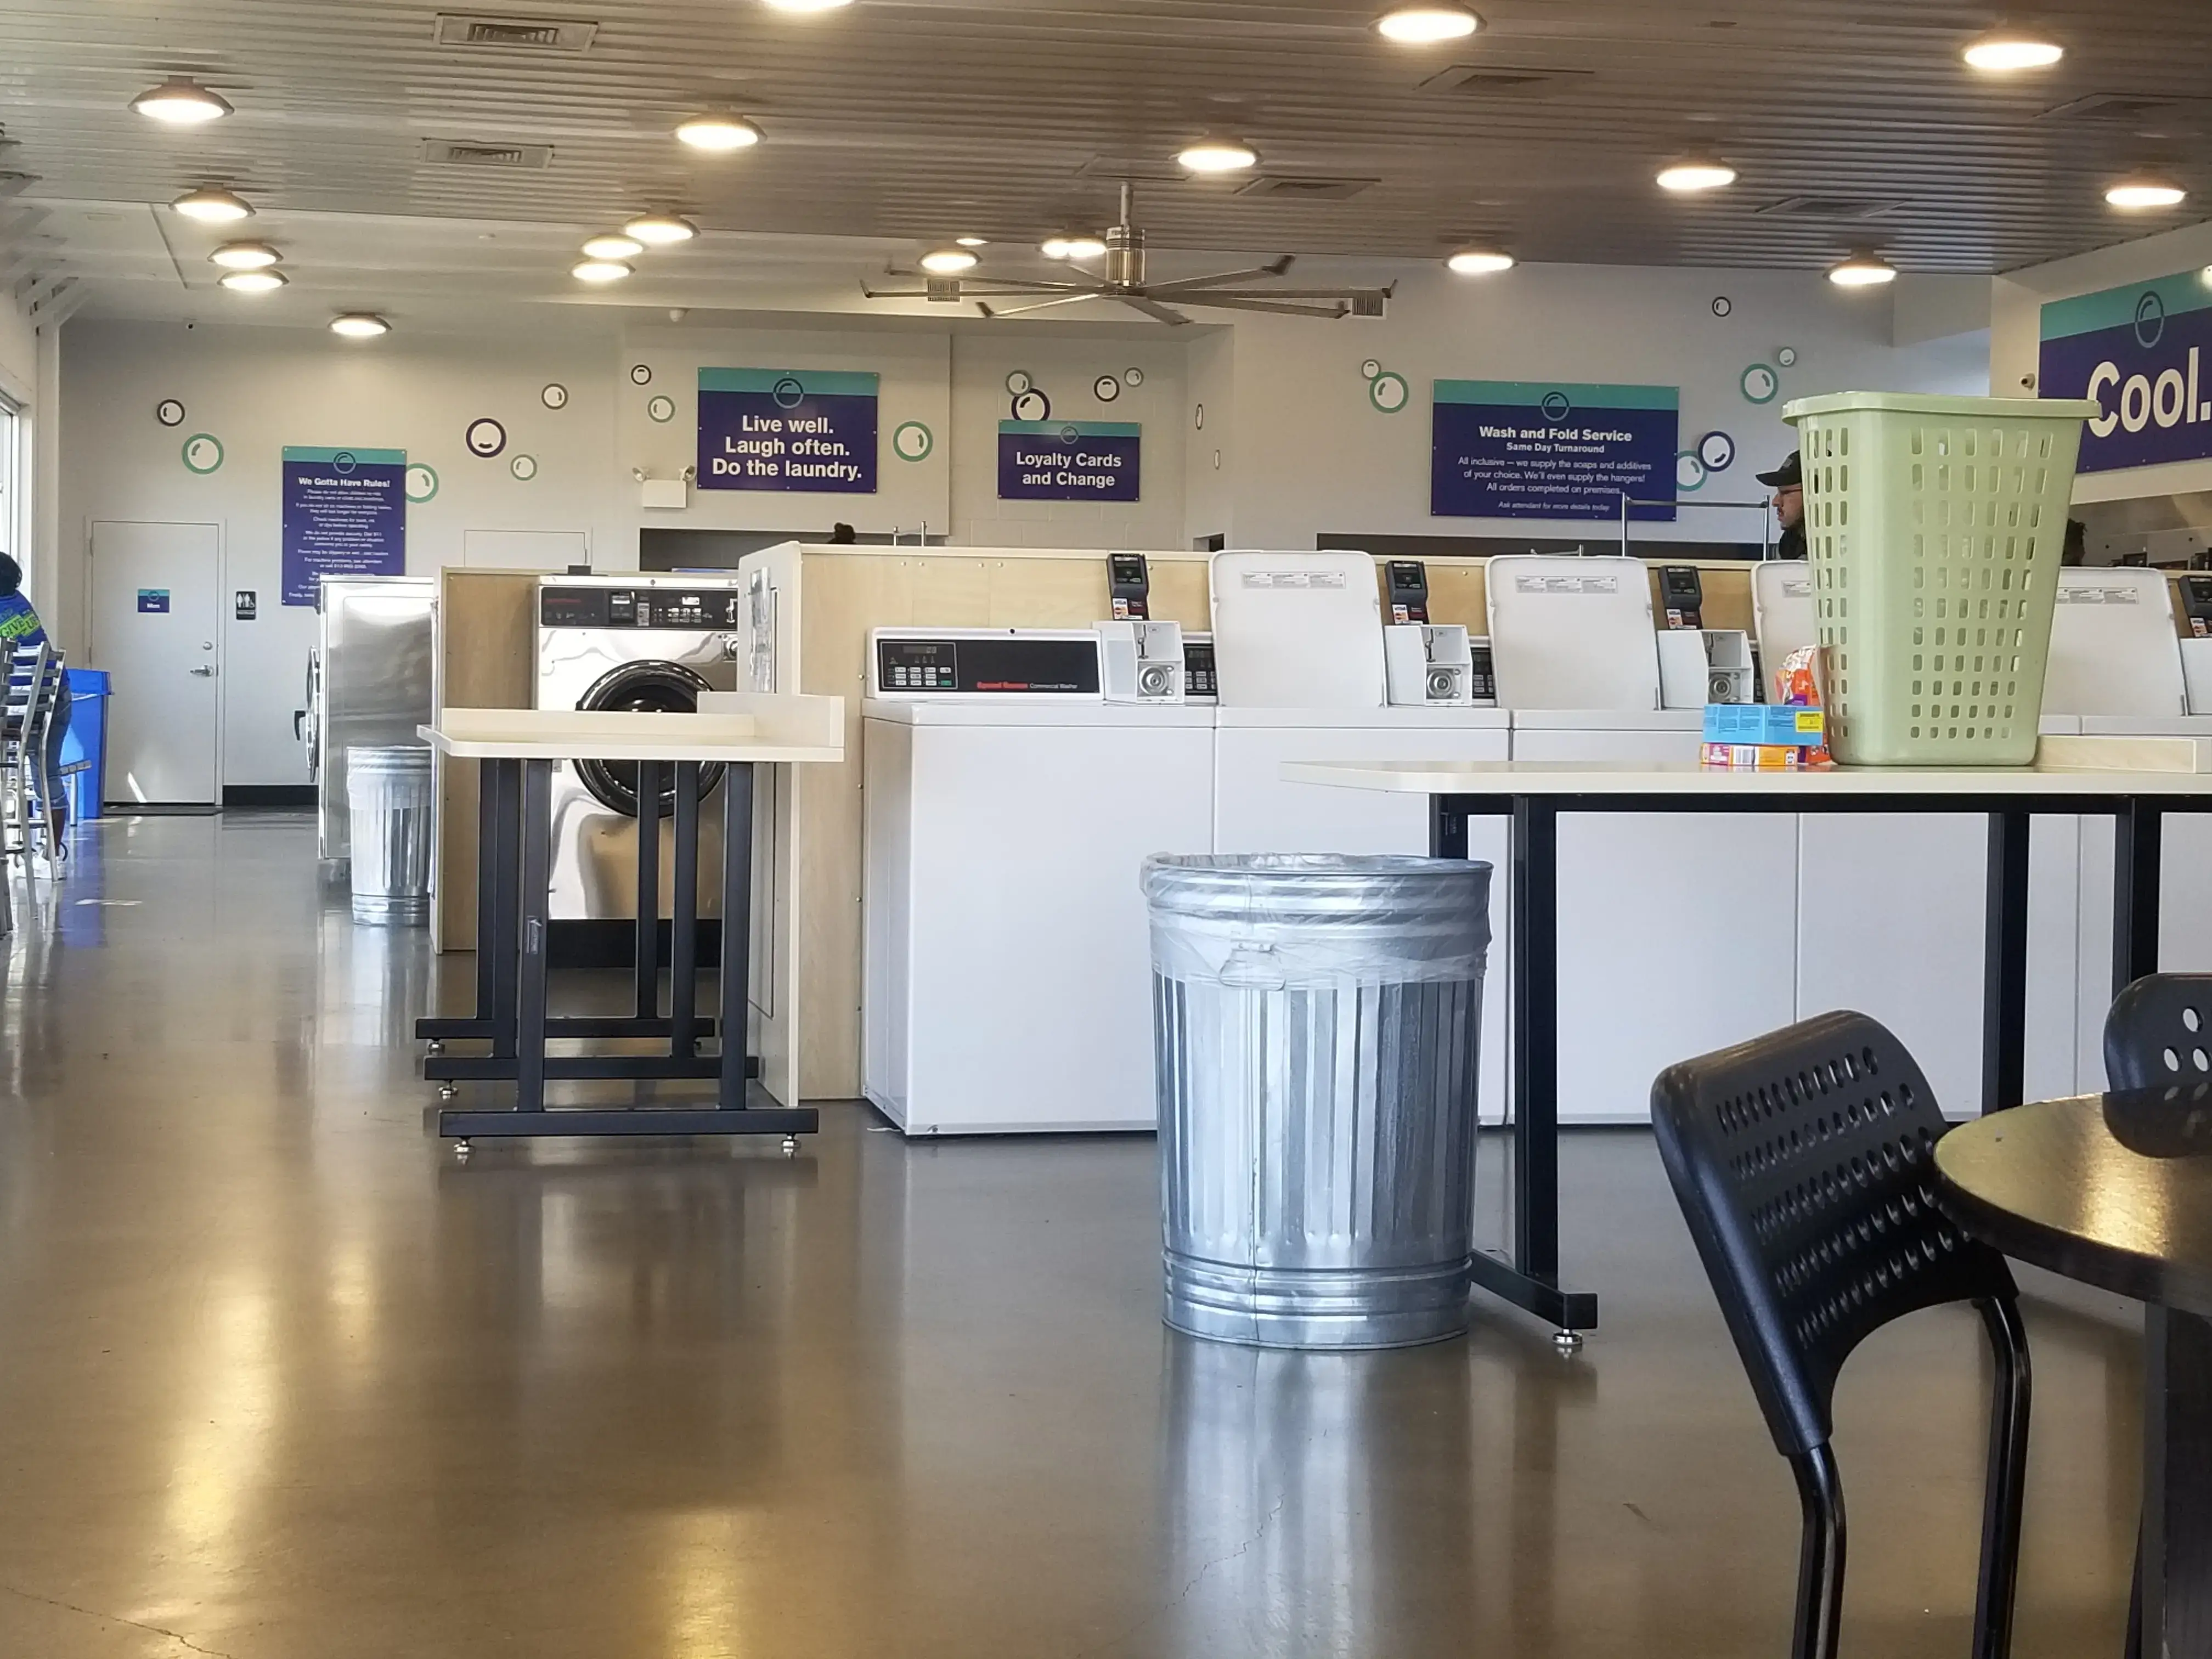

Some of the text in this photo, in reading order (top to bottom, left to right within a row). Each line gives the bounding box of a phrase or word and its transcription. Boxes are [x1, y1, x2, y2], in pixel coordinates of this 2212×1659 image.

[2087, 346, 2211, 438] Cool.
[742, 415, 834, 433] Live well.
[1479, 426, 1633, 441] Wash and Fold Service
[725, 436, 850, 457] Laugh often.
[1506, 442, 1605, 453] Same Day Turnaround
[1016, 452, 1122, 469] Loyalty Cards
[1458, 456, 1469, 465] All
[1470, 457, 1505, 466] inclusive
[1530, 460, 1557, 469] supply
[1559, 460, 1571, 468] the
[1616, 461, 1651, 470] additives
[713, 458, 862, 482] Do the laundry.
[1464, 470, 1472, 478] of
[1474, 471, 1492, 480] your
[1493, 471, 1522, 479] choice.
[1524, 471, 1545, 479] We'll
[1567, 473, 1594, 483] supply
[1596, 473, 1609, 482] the
[1611, 473, 1645, 484] hangers!
[298, 477, 313, 486] We
[314, 478, 338, 486] Gotta
[364, 479, 390, 488] Rules!
[1022, 472, 1115, 489] and Change
[1486, 482, 1497, 491] All
[1499, 483, 1525, 492] orders
[1527, 484, 1570, 494] completed
